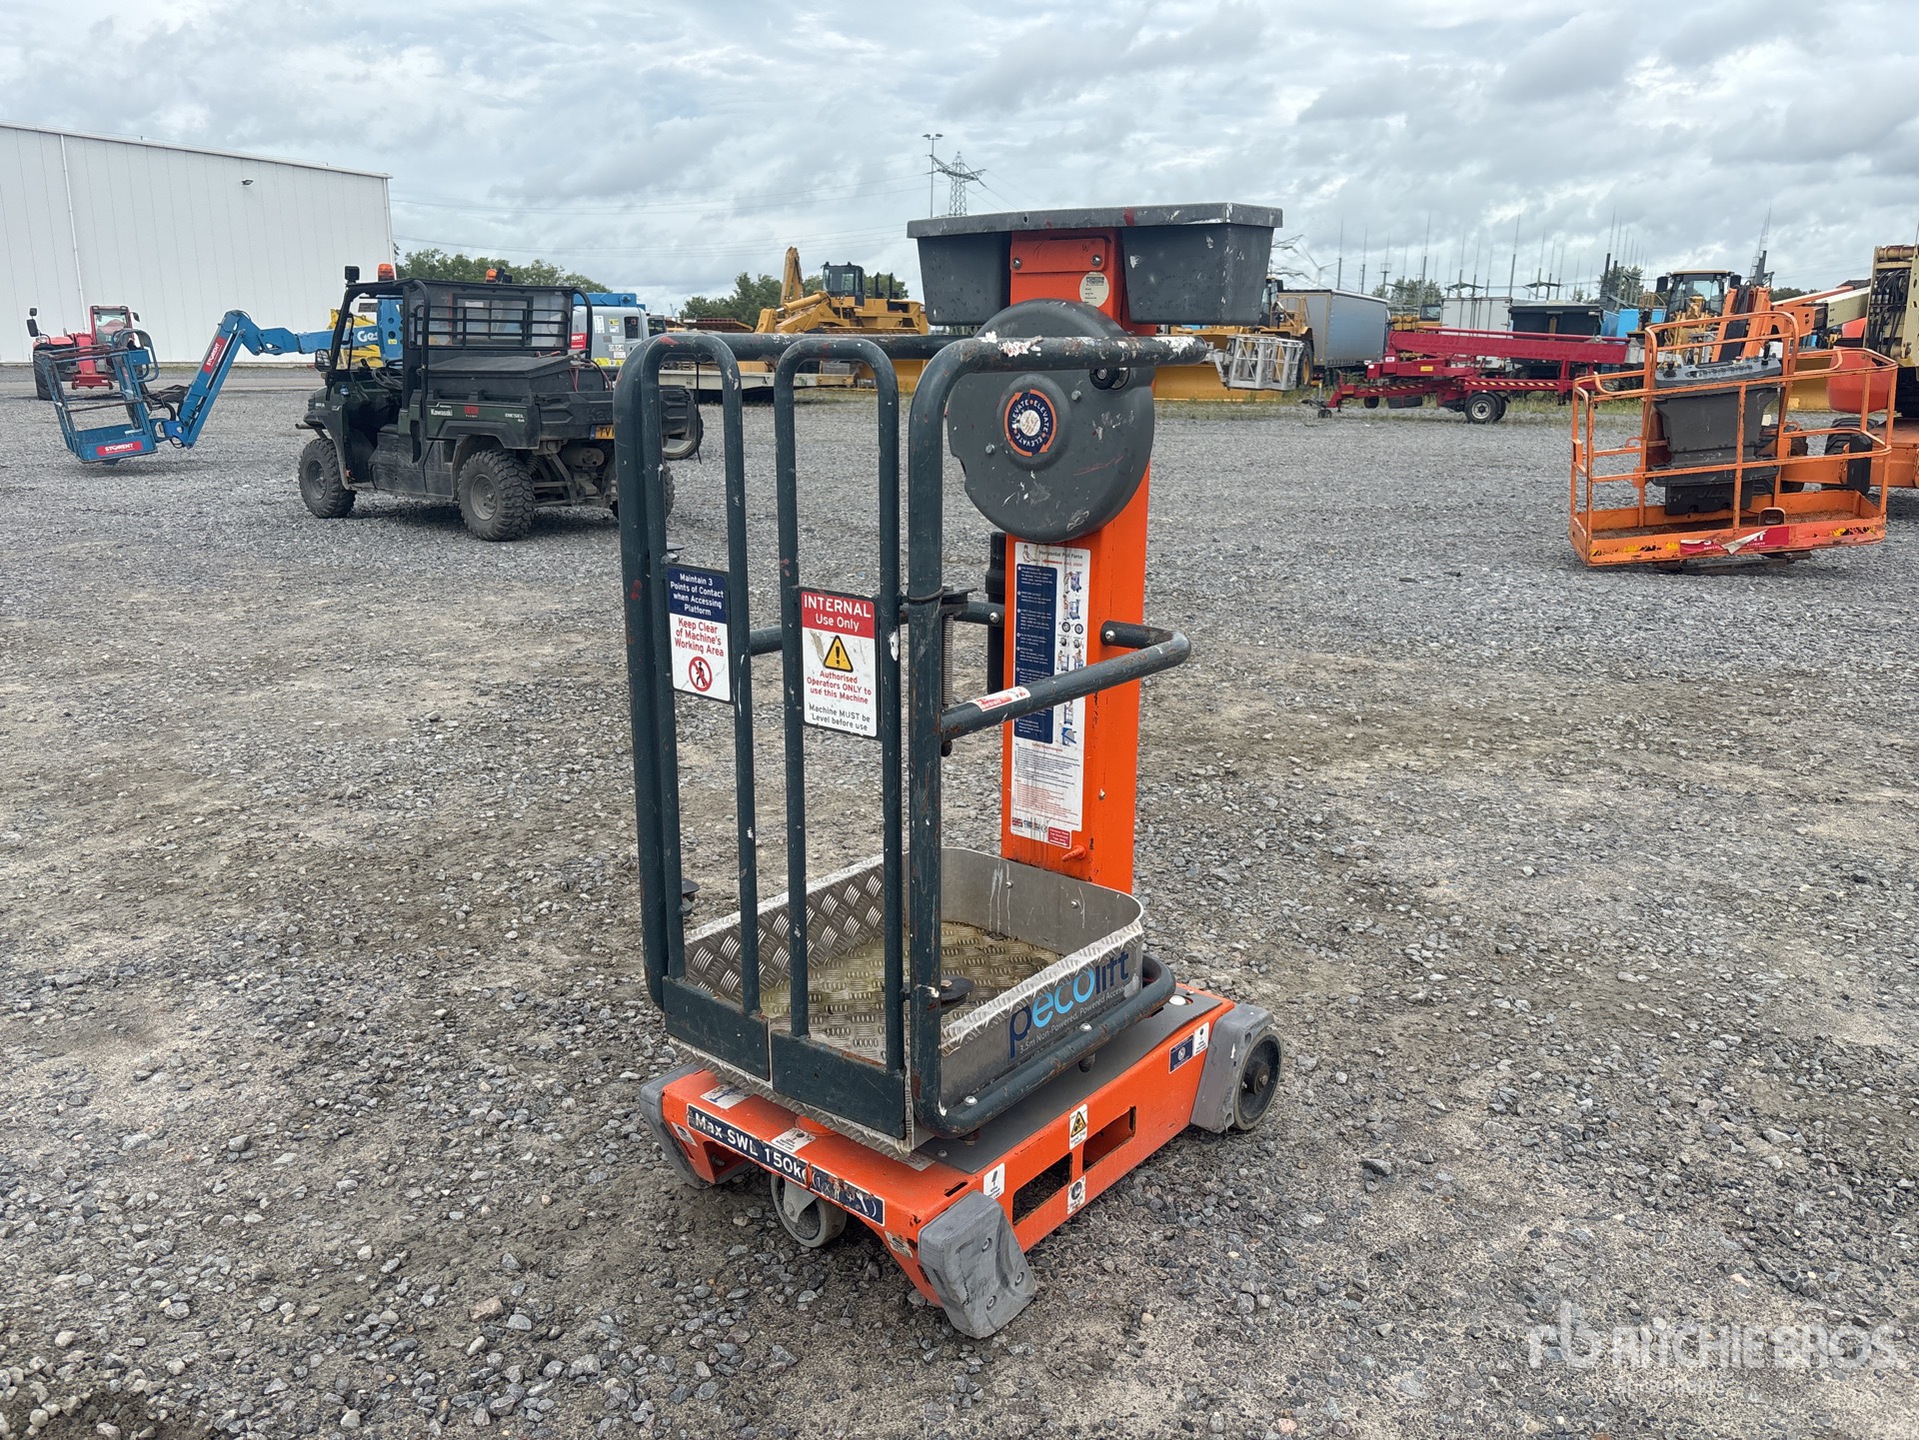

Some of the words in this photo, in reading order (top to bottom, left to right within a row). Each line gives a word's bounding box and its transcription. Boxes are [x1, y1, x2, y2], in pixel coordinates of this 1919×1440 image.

[430, 408, 453, 417] Kawasaki
[1033, 400, 1050, 432] ELEVATE
[105, 443, 134, 452] STORENT
[1015, 434, 1043, 447] ELEVATE
[680, 573, 706, 585] Maintain
[707, 578, 714, 587] 3
[670, 581, 690, 593] Points
[691, 585, 698, 593] of
[699, 587, 724, 598] Contact
[673, 593, 689, 601] when
[691, 596, 722, 609] Accessing
[804, 595, 871, 618] INTERNAL
[684, 605, 712, 616] Platform
[678, 617, 696, 631] Keep
[698, 622, 718, 634] Clear
[815, 613, 834, 627] Use
[836, 617, 860, 633] Only
[676, 628, 683, 637] of
[685, 630, 721, 645] Machine's
[674, 638, 704, 654] Working
[706, 646, 724, 657] Area
[819, 670, 858, 684] Authorised
[806, 676, 840, 690] Operators
[843, 683, 862, 694] ONLY
[863, 686, 872, 697] to
[810, 686, 822, 696] use
[823, 688, 838, 699] this
[839, 692, 868, 705] Machine
[808, 702, 837, 716] Machine
[839, 708, 860, 720] MUST
[861, 713, 871, 723] be
[811, 713, 831, 723] Level
[831, 716, 854, 728] before
[855, 722, 868, 731] use
[1009, 951, 1129, 1059] pecolift
[1080, 995, 1106, 1015] Powered
[695, 1113, 723, 1139] Max
[727, 1129, 759, 1157] SWL
